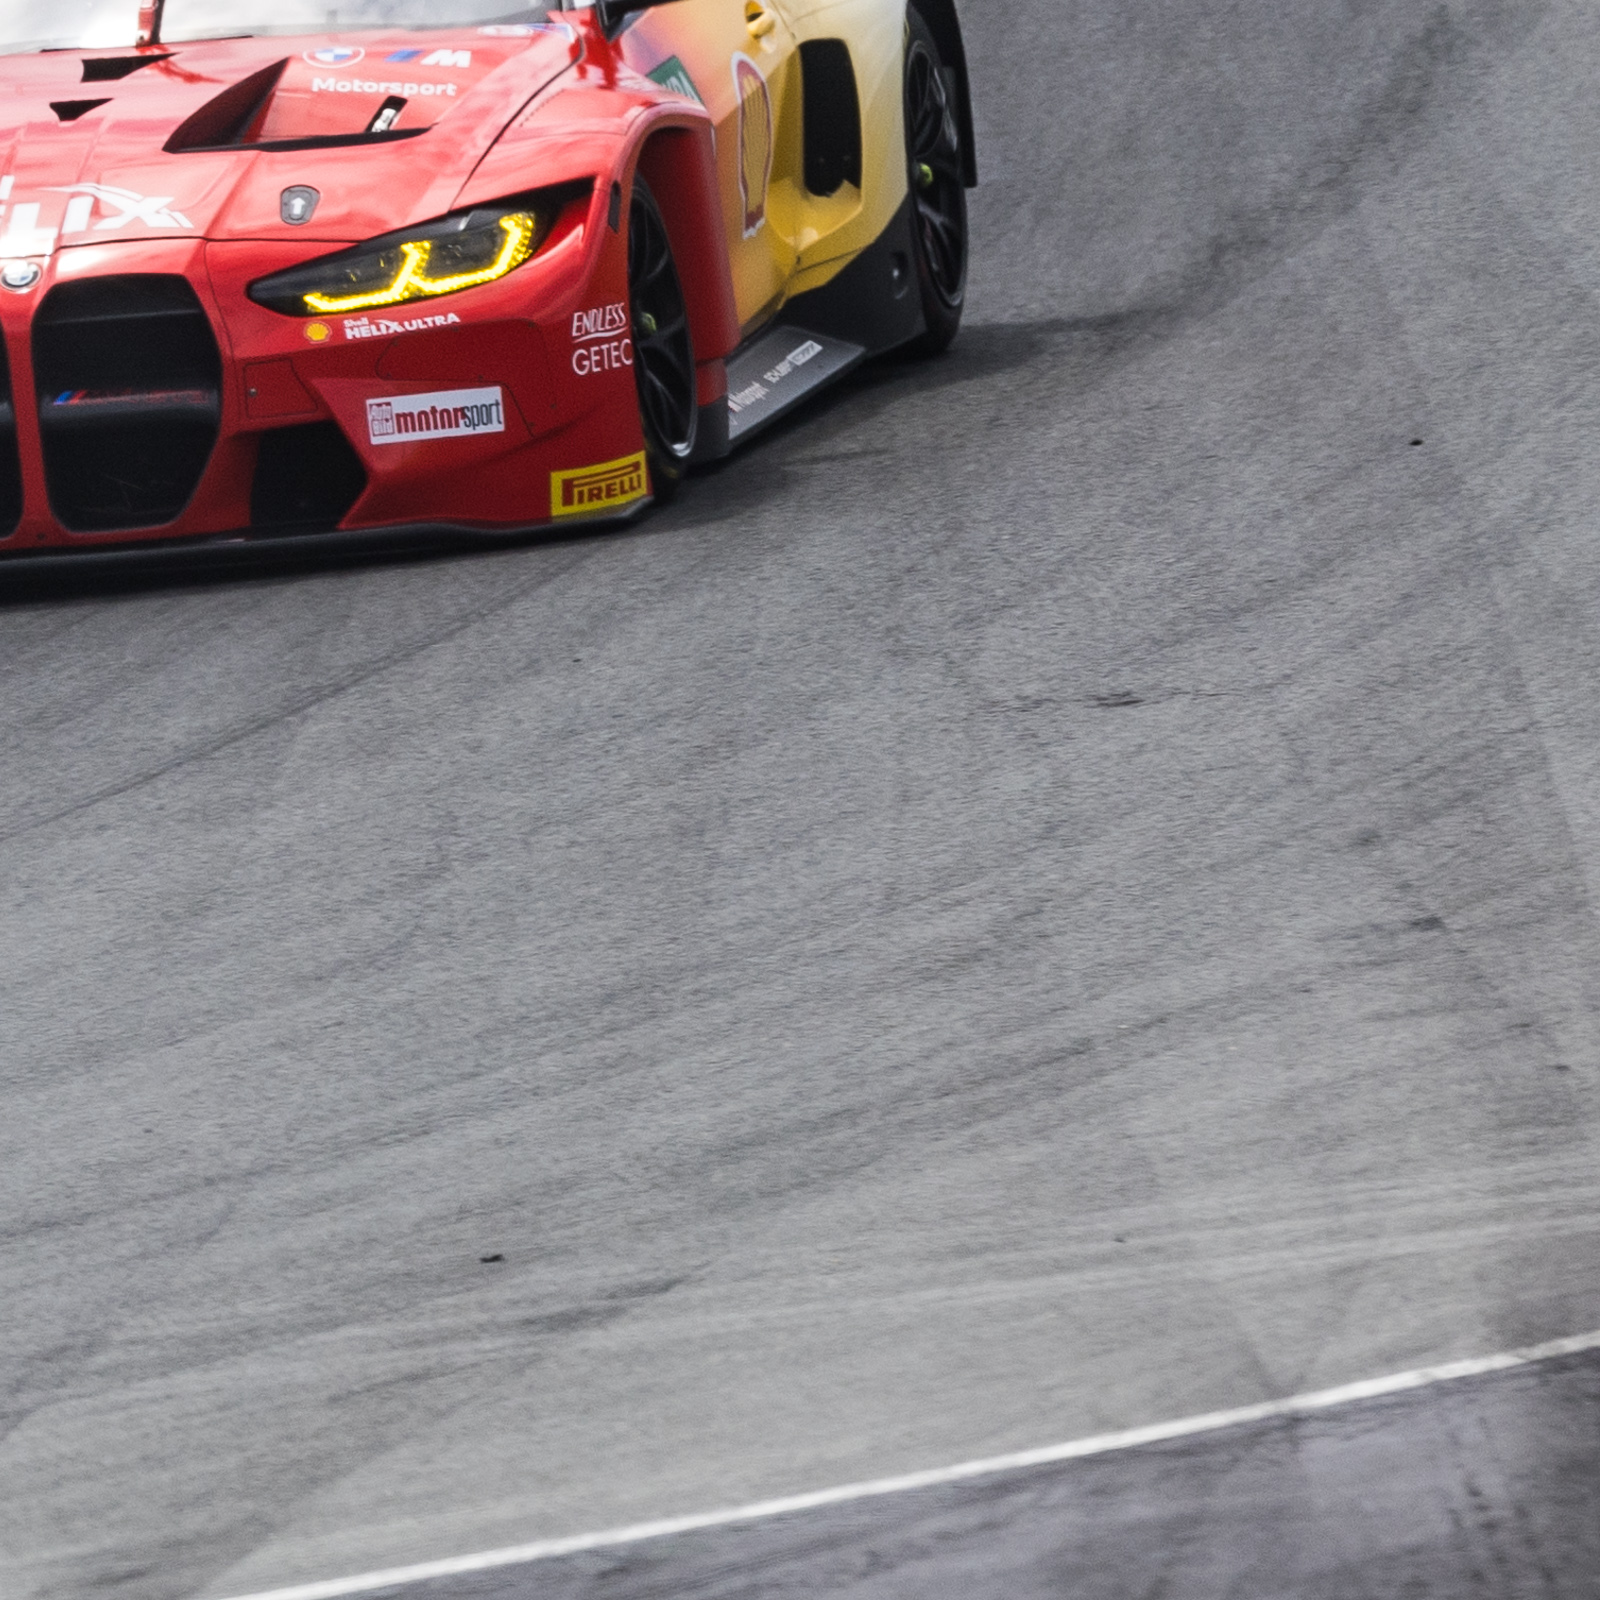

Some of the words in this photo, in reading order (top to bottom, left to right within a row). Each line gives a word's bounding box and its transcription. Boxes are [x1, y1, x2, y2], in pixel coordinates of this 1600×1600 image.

[311, 76, 458, 97] Motorsport
[343, 316, 370, 327] Shell
[403, 312, 461, 331] ULTRA
[571, 301, 628, 340] ENDLESS
[571, 337, 635, 376] GETEC
[394, 398, 503, 435] motorsport
[561, 459, 645, 507] PIRELLI
